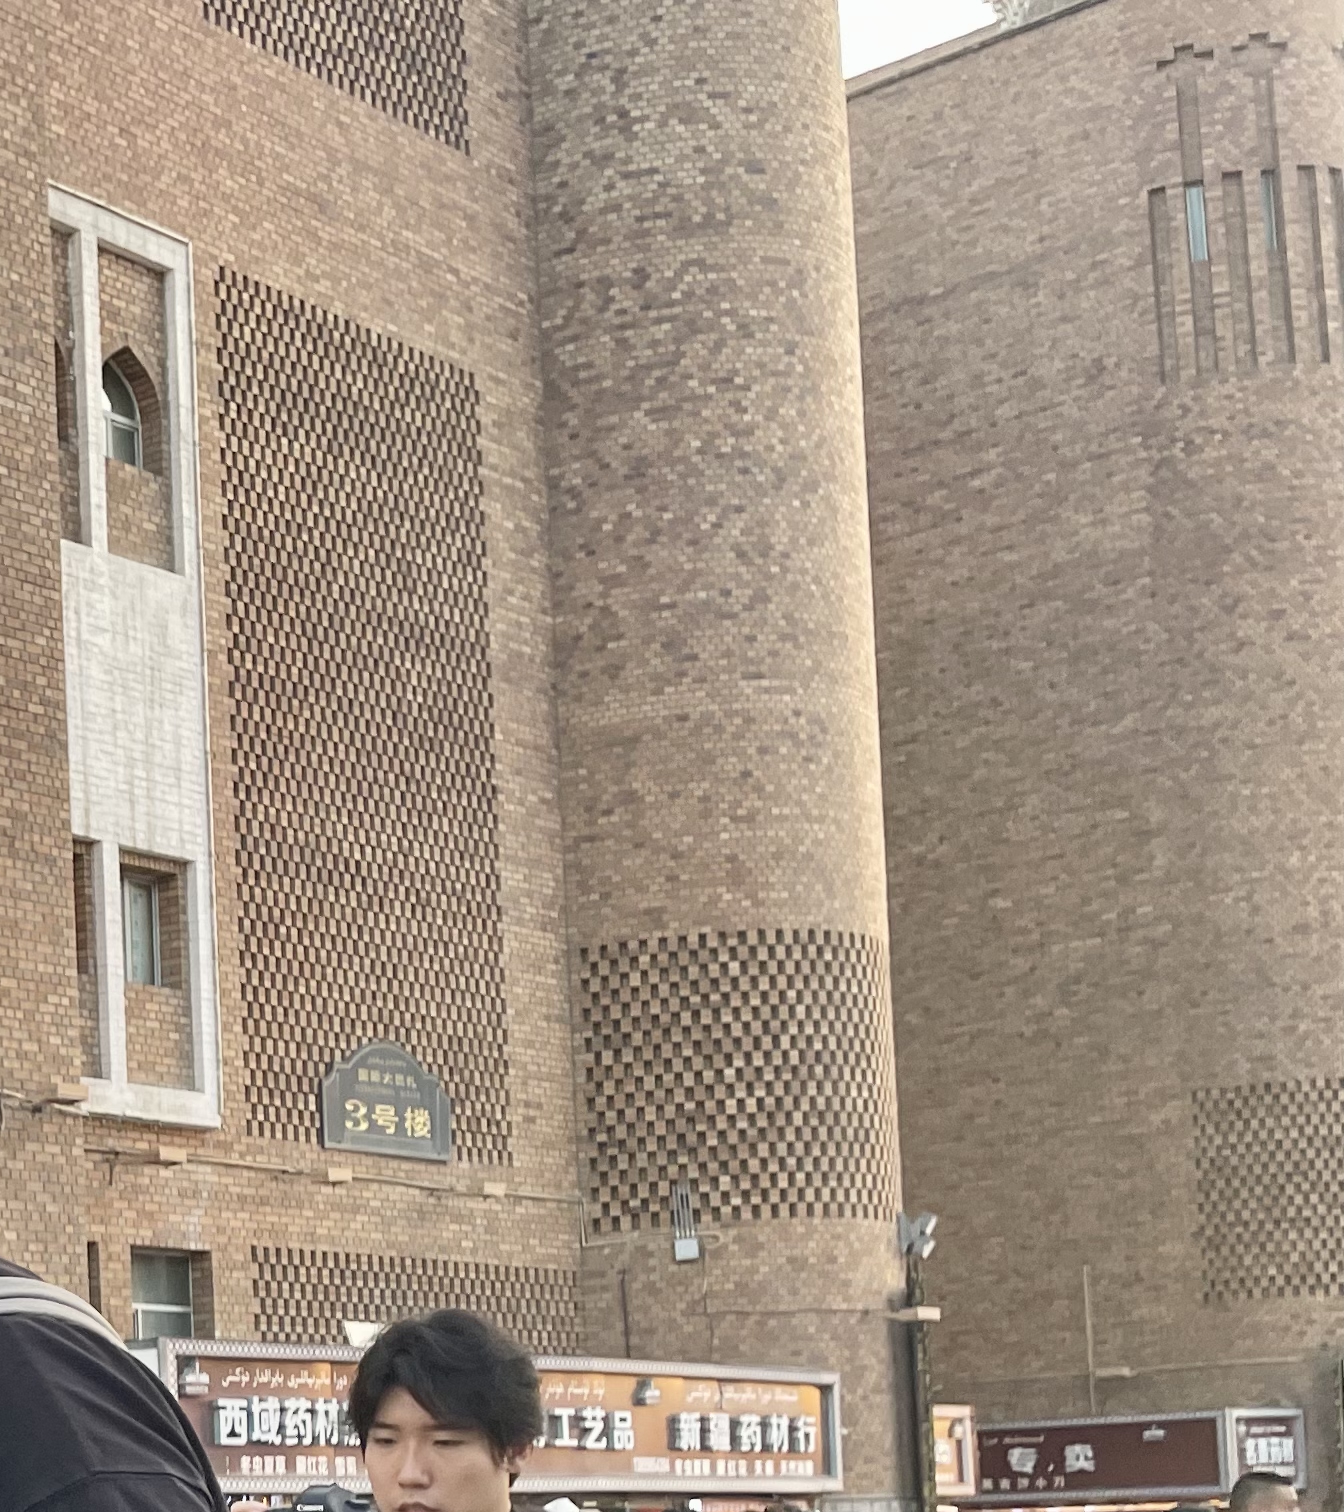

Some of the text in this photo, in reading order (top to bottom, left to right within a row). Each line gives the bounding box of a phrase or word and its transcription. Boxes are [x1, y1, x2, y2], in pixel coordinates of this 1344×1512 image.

[344, 1099, 432, 1139] 3号楼
[536, 1406, 635, 1450] 工艺品
[677, 1410, 818, 1454] 新疆药材行
